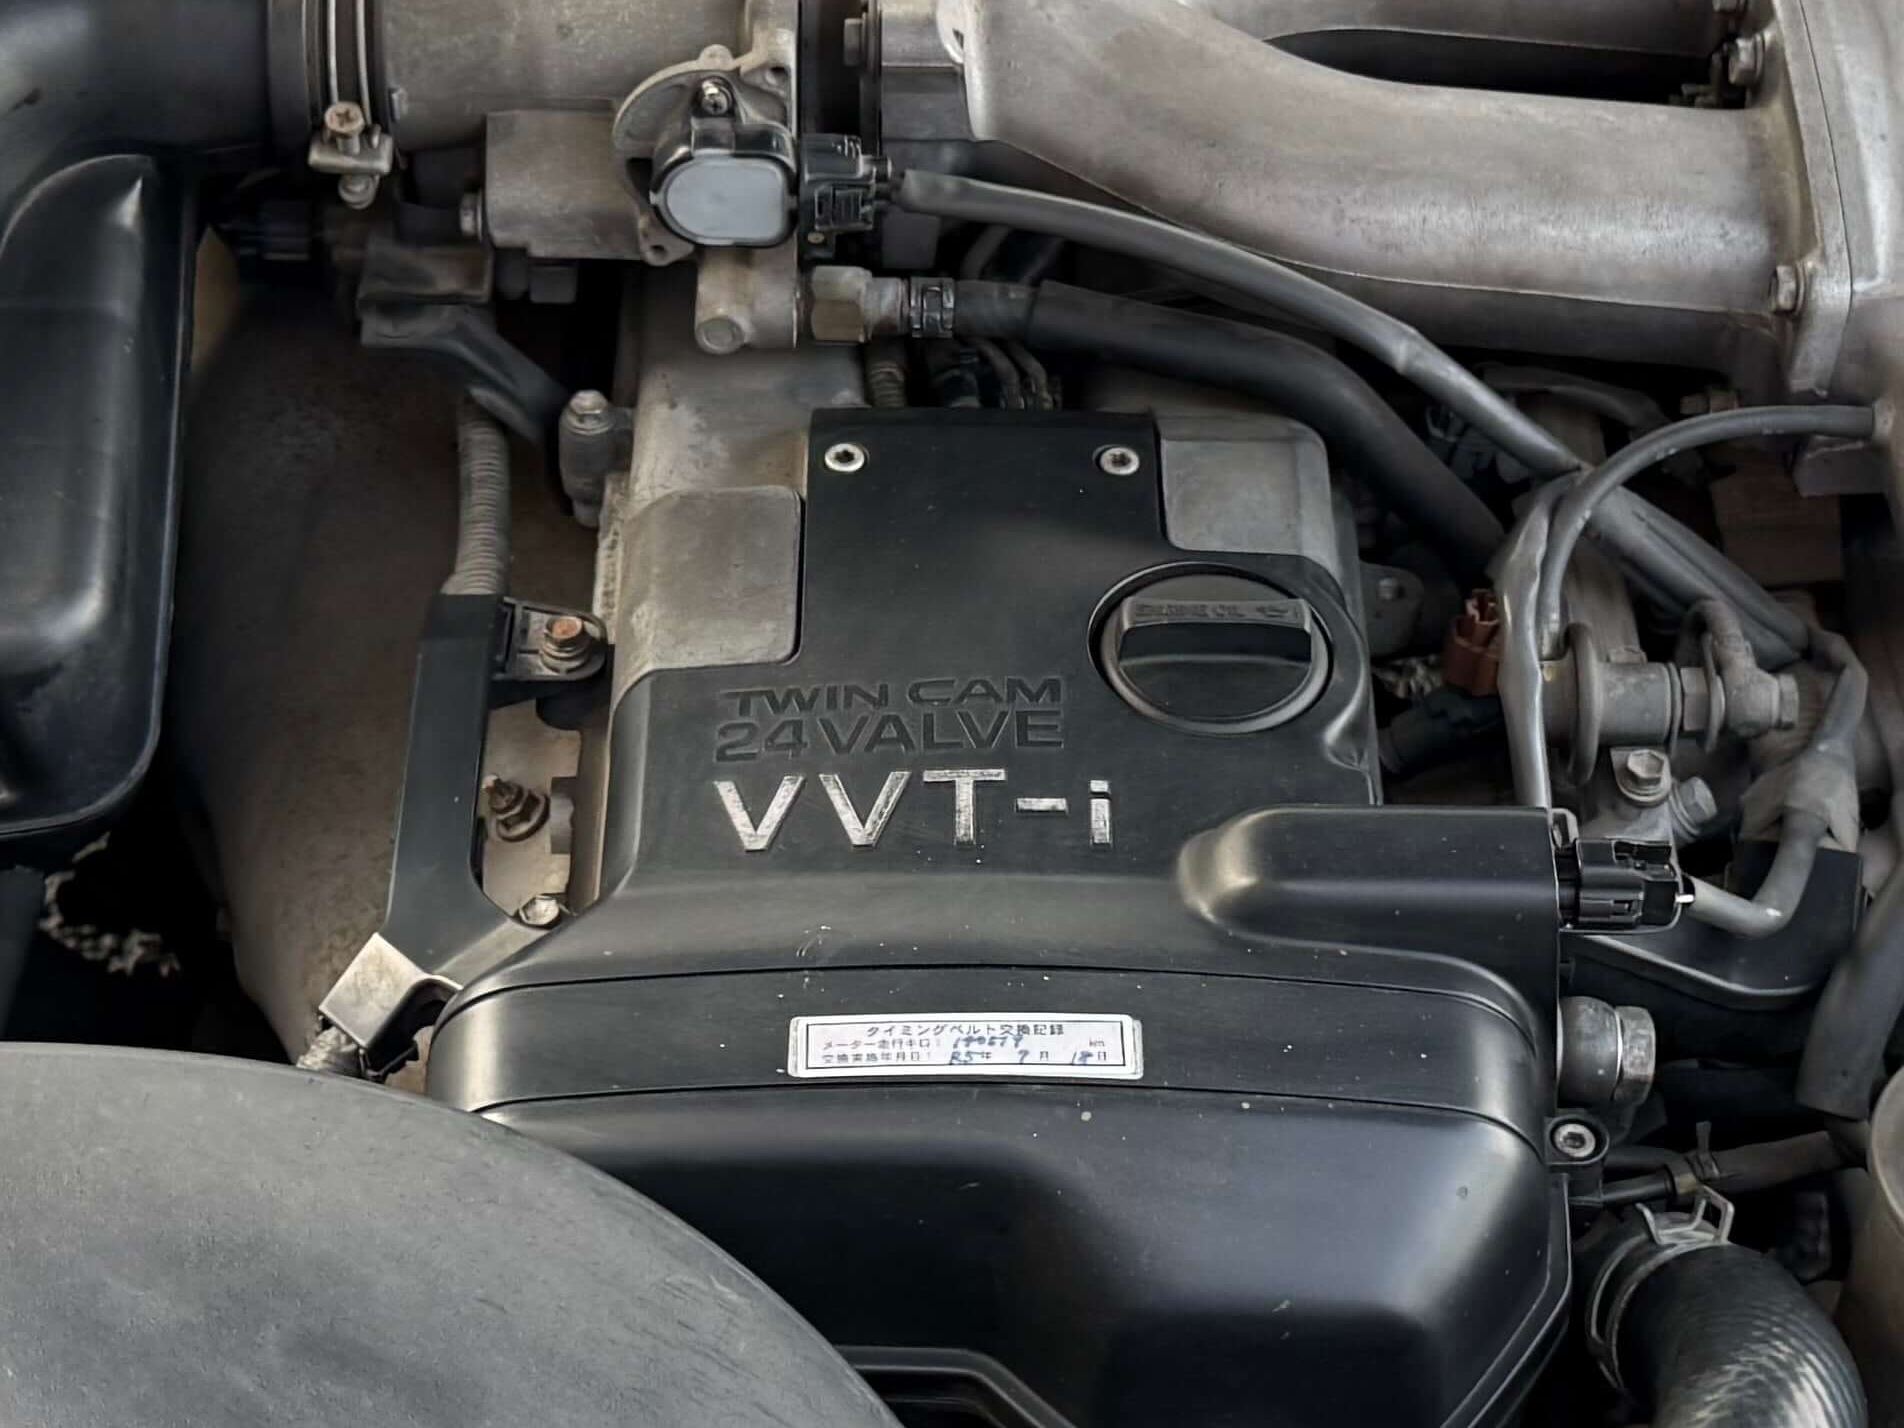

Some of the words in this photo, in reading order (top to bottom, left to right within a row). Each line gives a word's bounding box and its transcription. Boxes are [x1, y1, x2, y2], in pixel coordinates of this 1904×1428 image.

[720, 682, 889, 718] TWIN
[905, 675, 1064, 708] CAM
[713, 768, 1114, 852] VVT-i
[866, 1023, 1066, 1038] タイミングベルト交換記録
